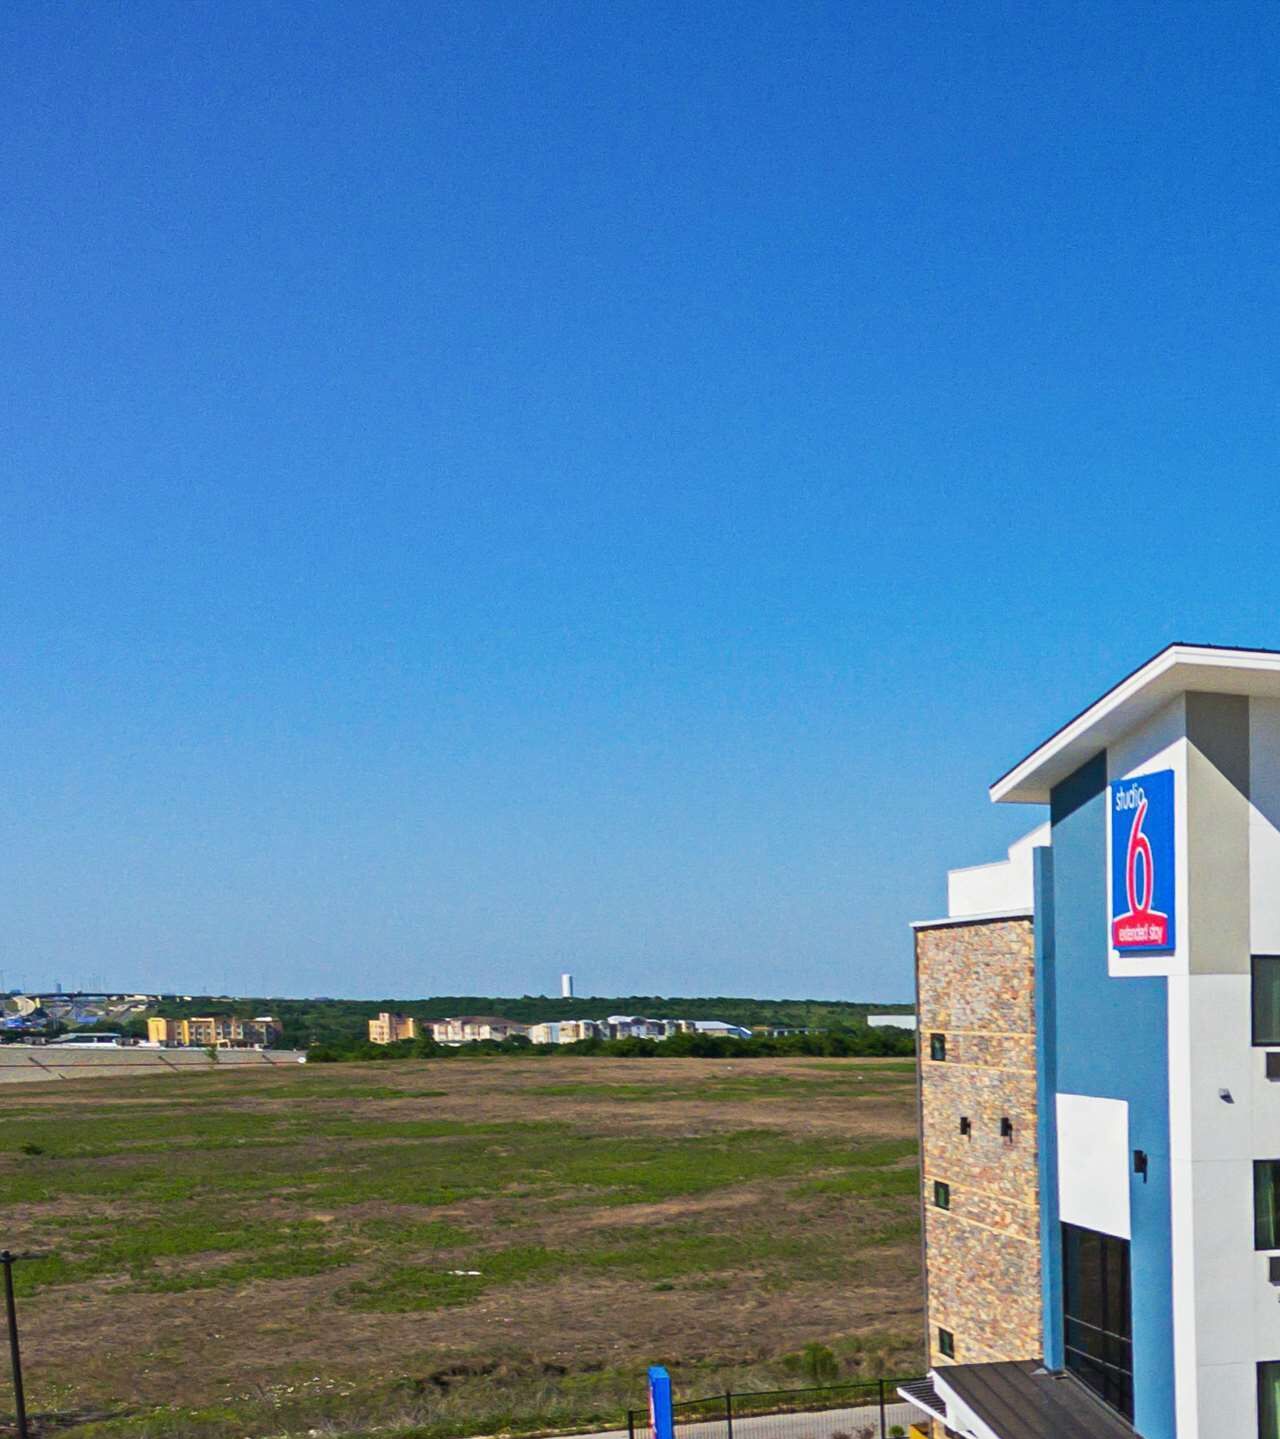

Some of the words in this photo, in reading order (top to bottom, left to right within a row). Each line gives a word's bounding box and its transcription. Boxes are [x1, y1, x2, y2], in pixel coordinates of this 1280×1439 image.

[1116, 783, 1145, 811] studio
[1126, 798, 1154, 914] 6
[1119, 924, 1148, 942] extended
[1149, 925, 1163, 944] stay
